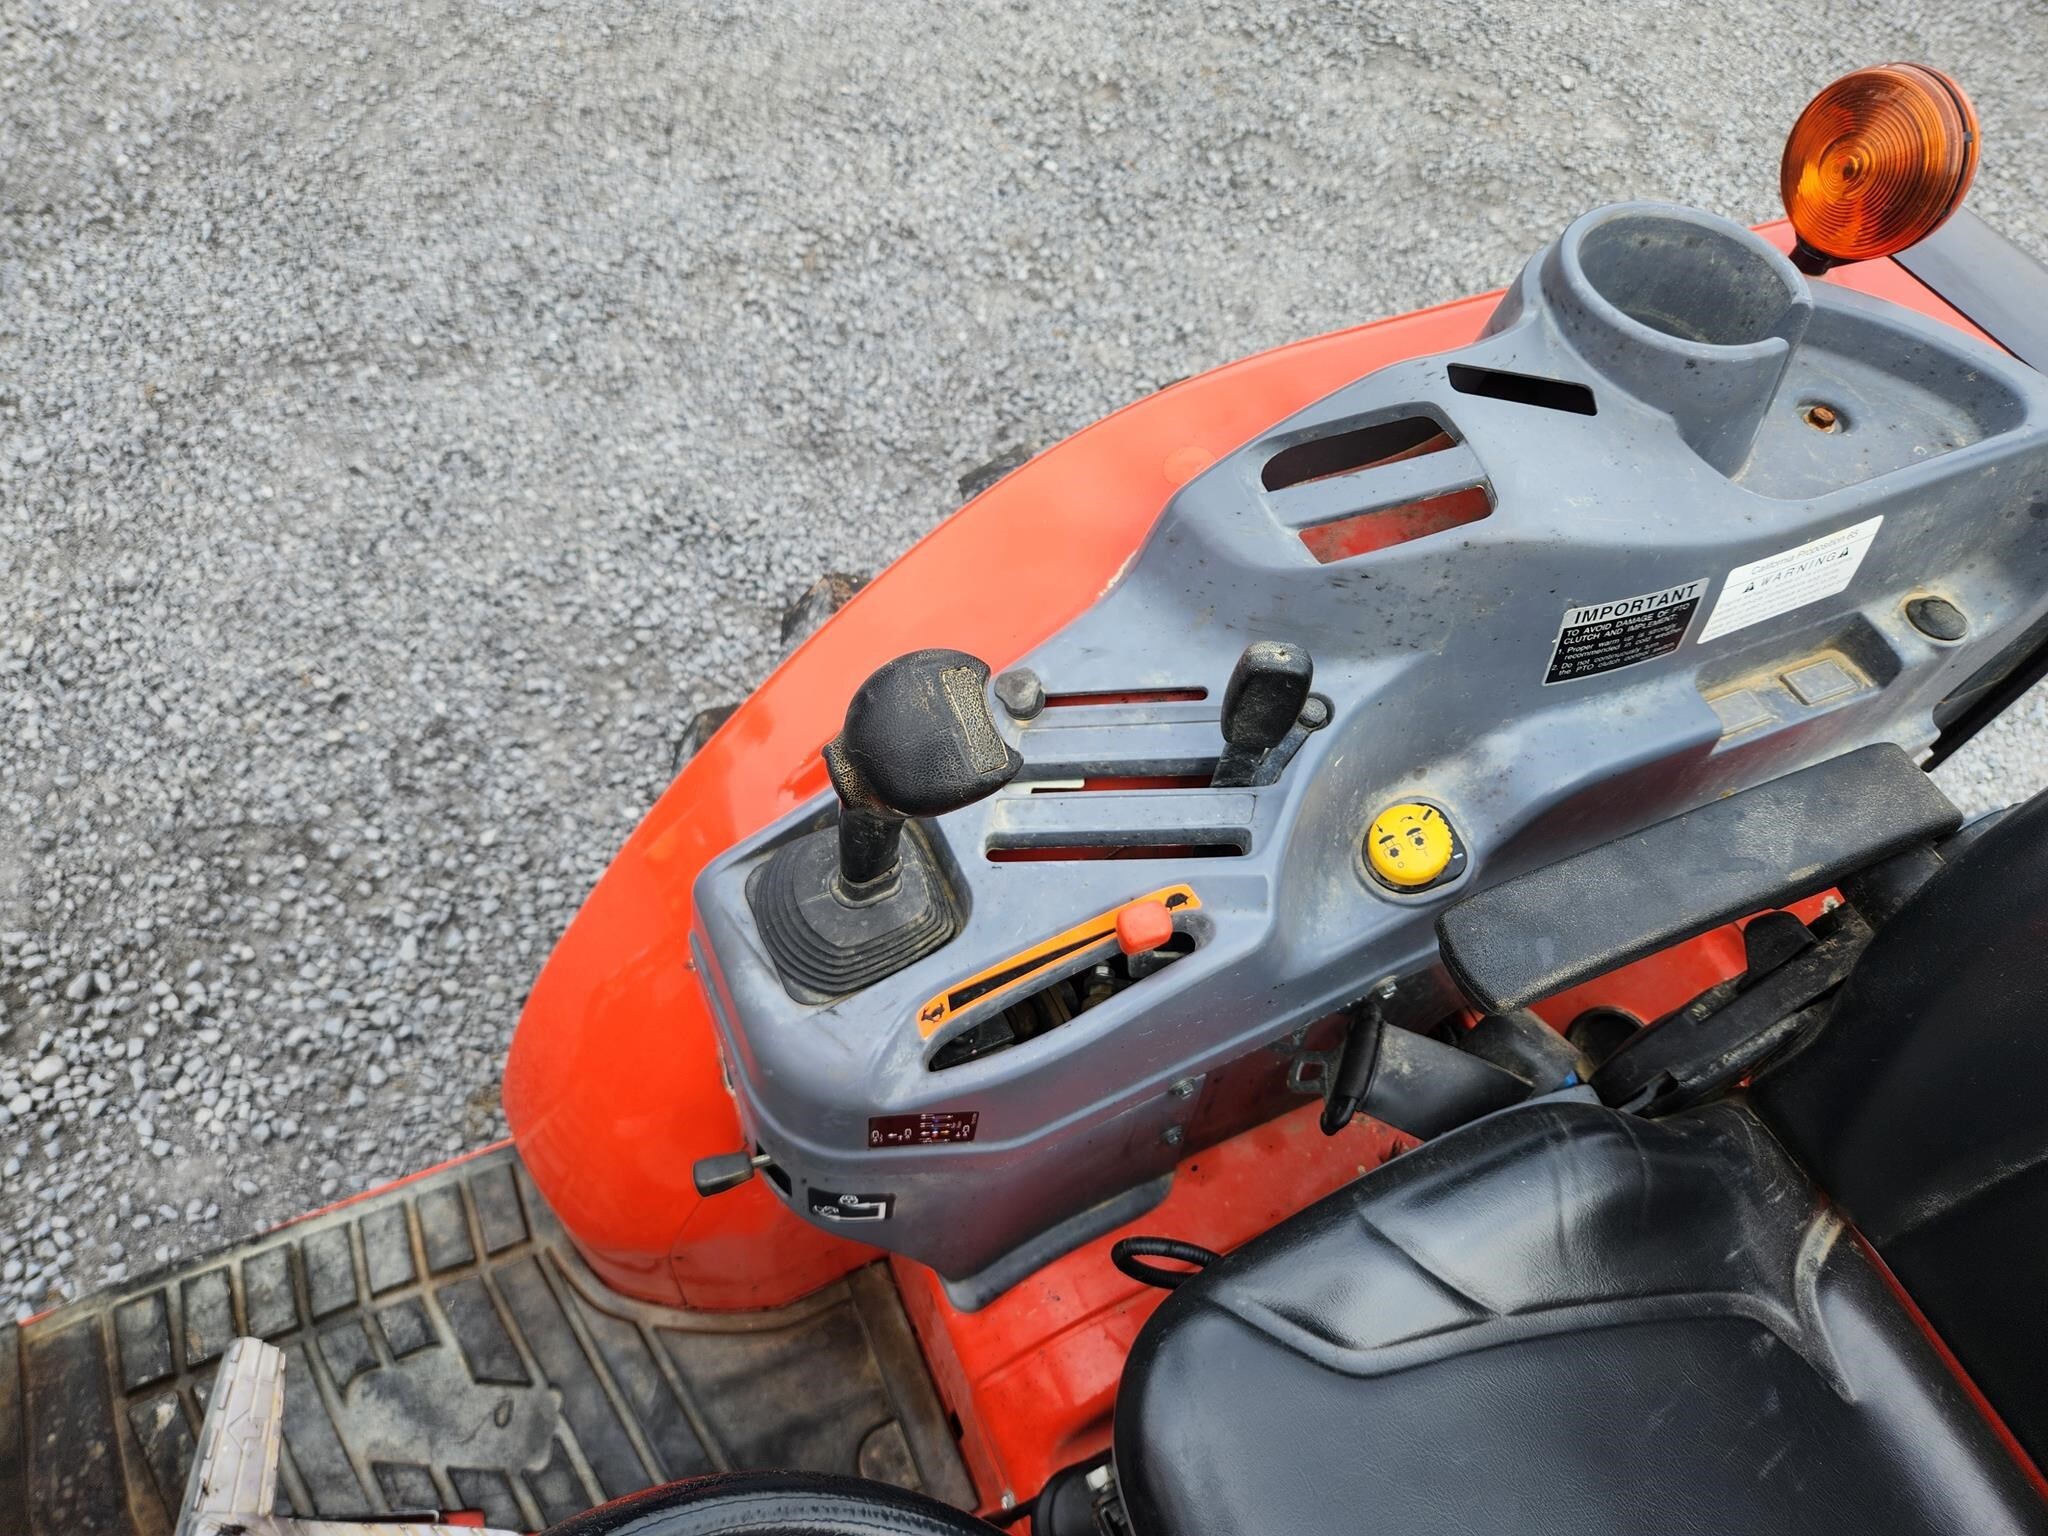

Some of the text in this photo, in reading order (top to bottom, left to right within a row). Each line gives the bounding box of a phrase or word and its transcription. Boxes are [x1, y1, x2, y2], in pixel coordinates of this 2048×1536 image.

[1761, 554, 1837, 586] WARNING
[1574, 584, 1698, 624] IMPORTANT
[1583, 623, 1612, 635] AVOID
[1616, 614, 1653, 628] DAMAGE
[1657, 609, 1670, 618] OF
[1564, 633, 1600, 645] CLUTCH
[1605, 628, 1624, 637] AND
[1567, 644, 1594, 654] Proper
[1598, 639, 1620, 648] warm
[1559, 668, 1571, 676] the
[1576, 663, 1594, 672] PTO
[1561, 662, 1572, 670] Do
